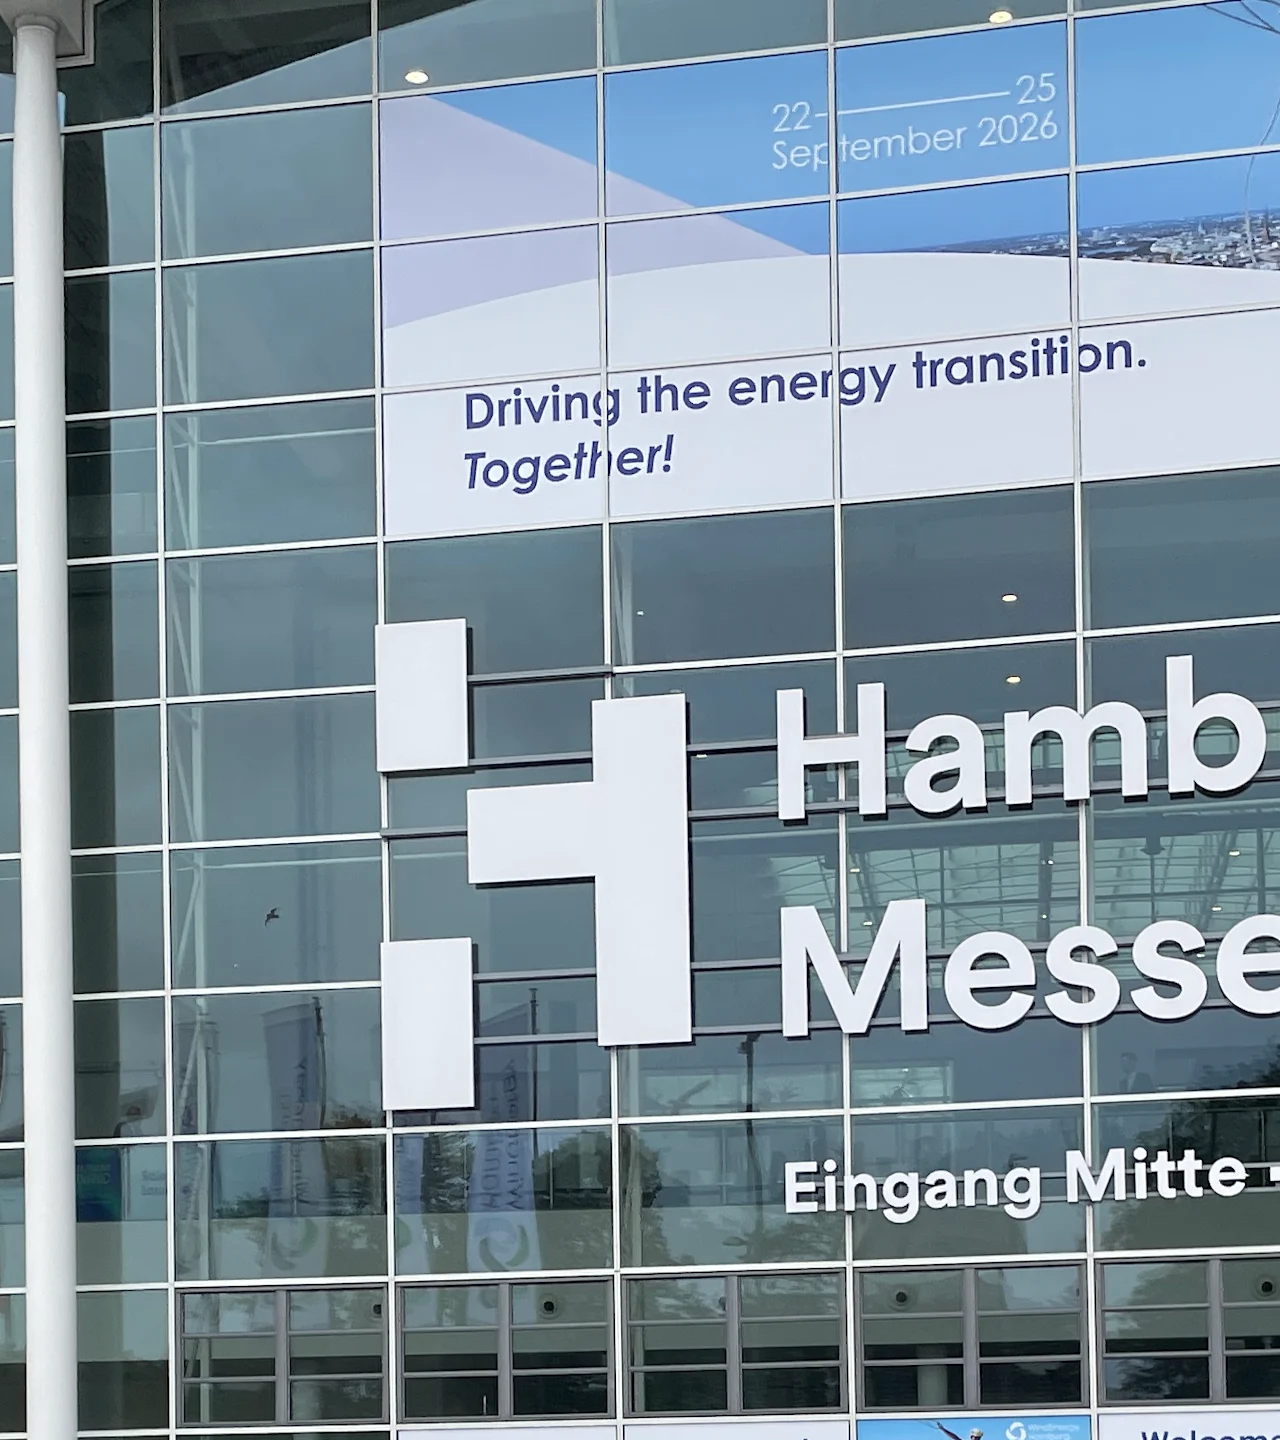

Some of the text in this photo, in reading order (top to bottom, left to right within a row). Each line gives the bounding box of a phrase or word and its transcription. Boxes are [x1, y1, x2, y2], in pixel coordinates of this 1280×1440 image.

[772, 73, 1057, 133] 22 25
[771, 110, 1059, 172] September 2026
[464, 335, 1147, 432] Driving the energy transition.
[463, 435, 675, 495] Together!
[784, 1159, 1043, 1224] Eingang
[1066, 1147, 1248, 1203] Mitte
